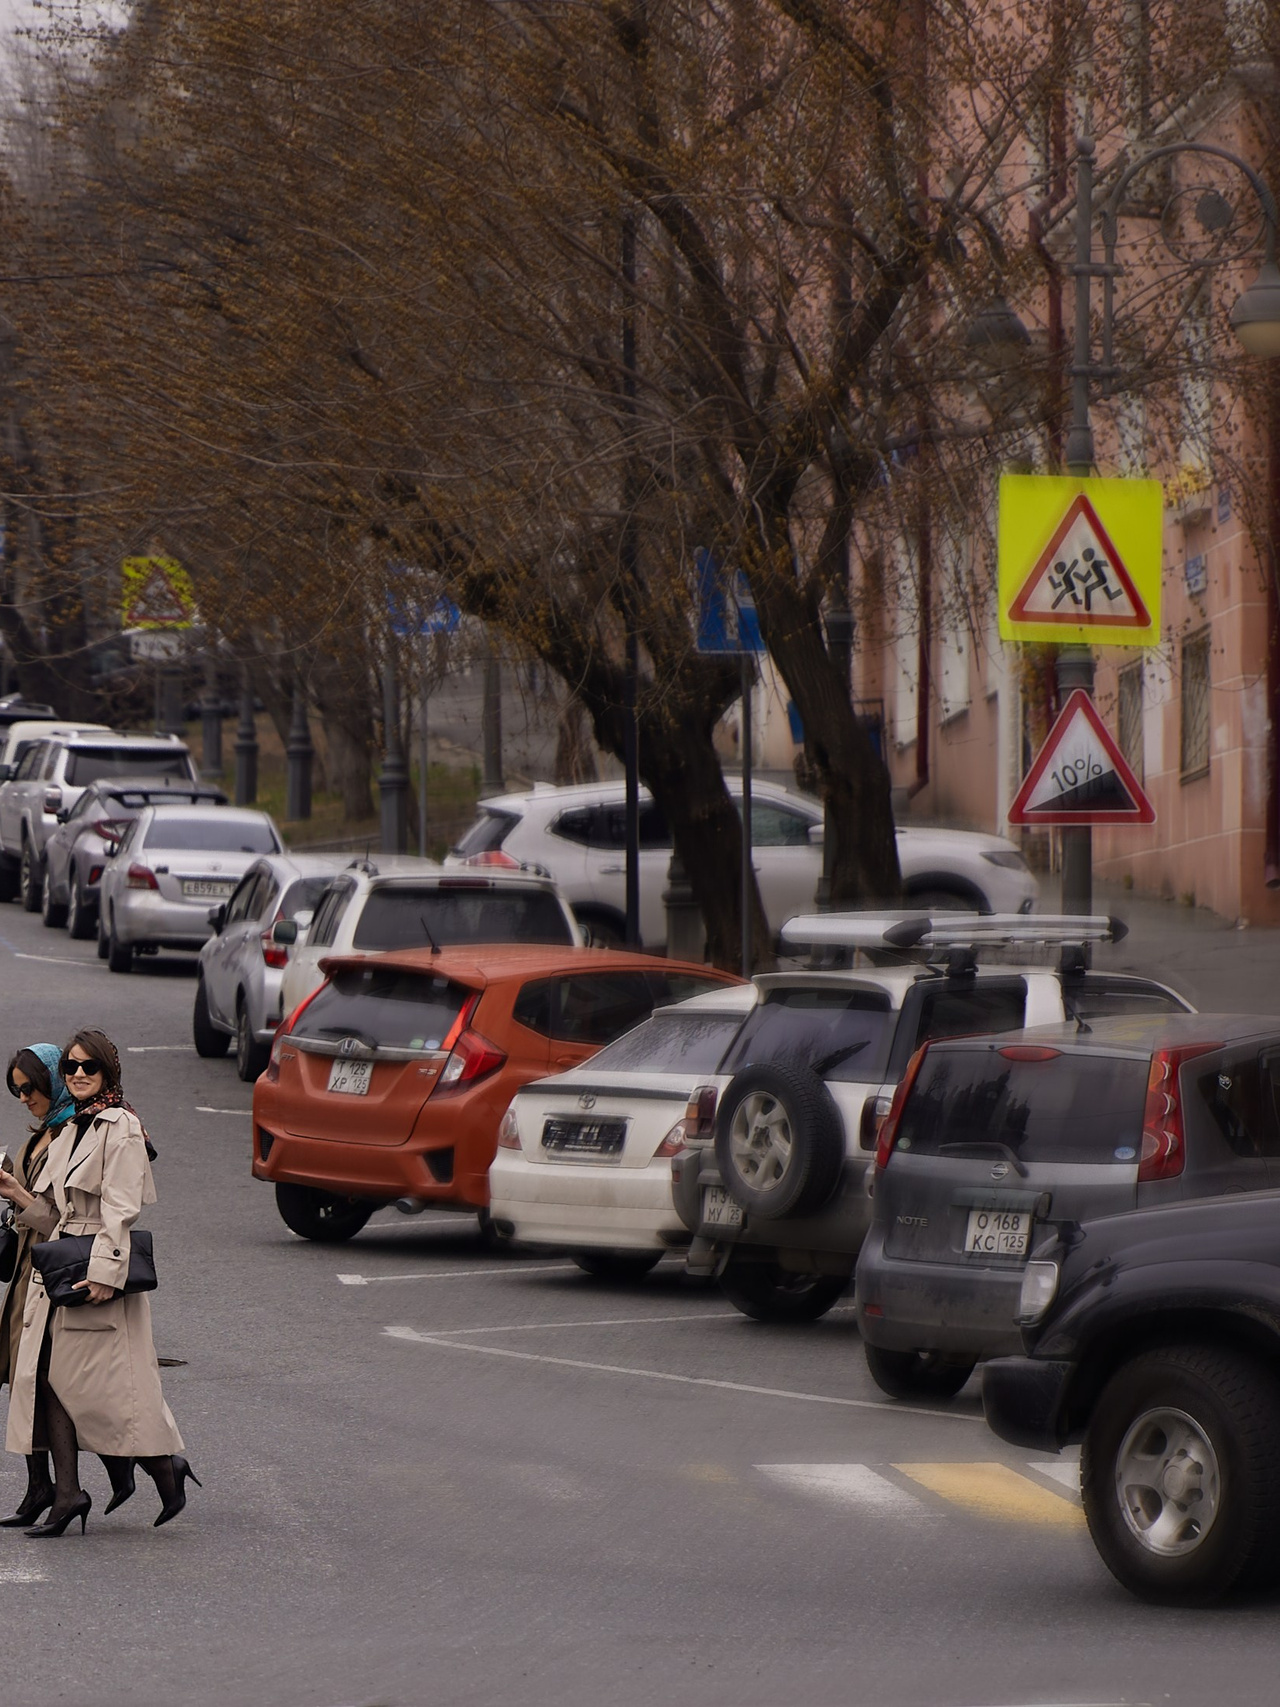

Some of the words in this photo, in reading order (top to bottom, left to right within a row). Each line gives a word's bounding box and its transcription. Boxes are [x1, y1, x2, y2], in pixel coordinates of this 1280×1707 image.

[1051, 753, 1102, 792] 10%
[896, 1215, 929, 1227] NOTE
[993, 1214, 1020, 1231] 168
[1002, 1235, 1024, 1249] 125
